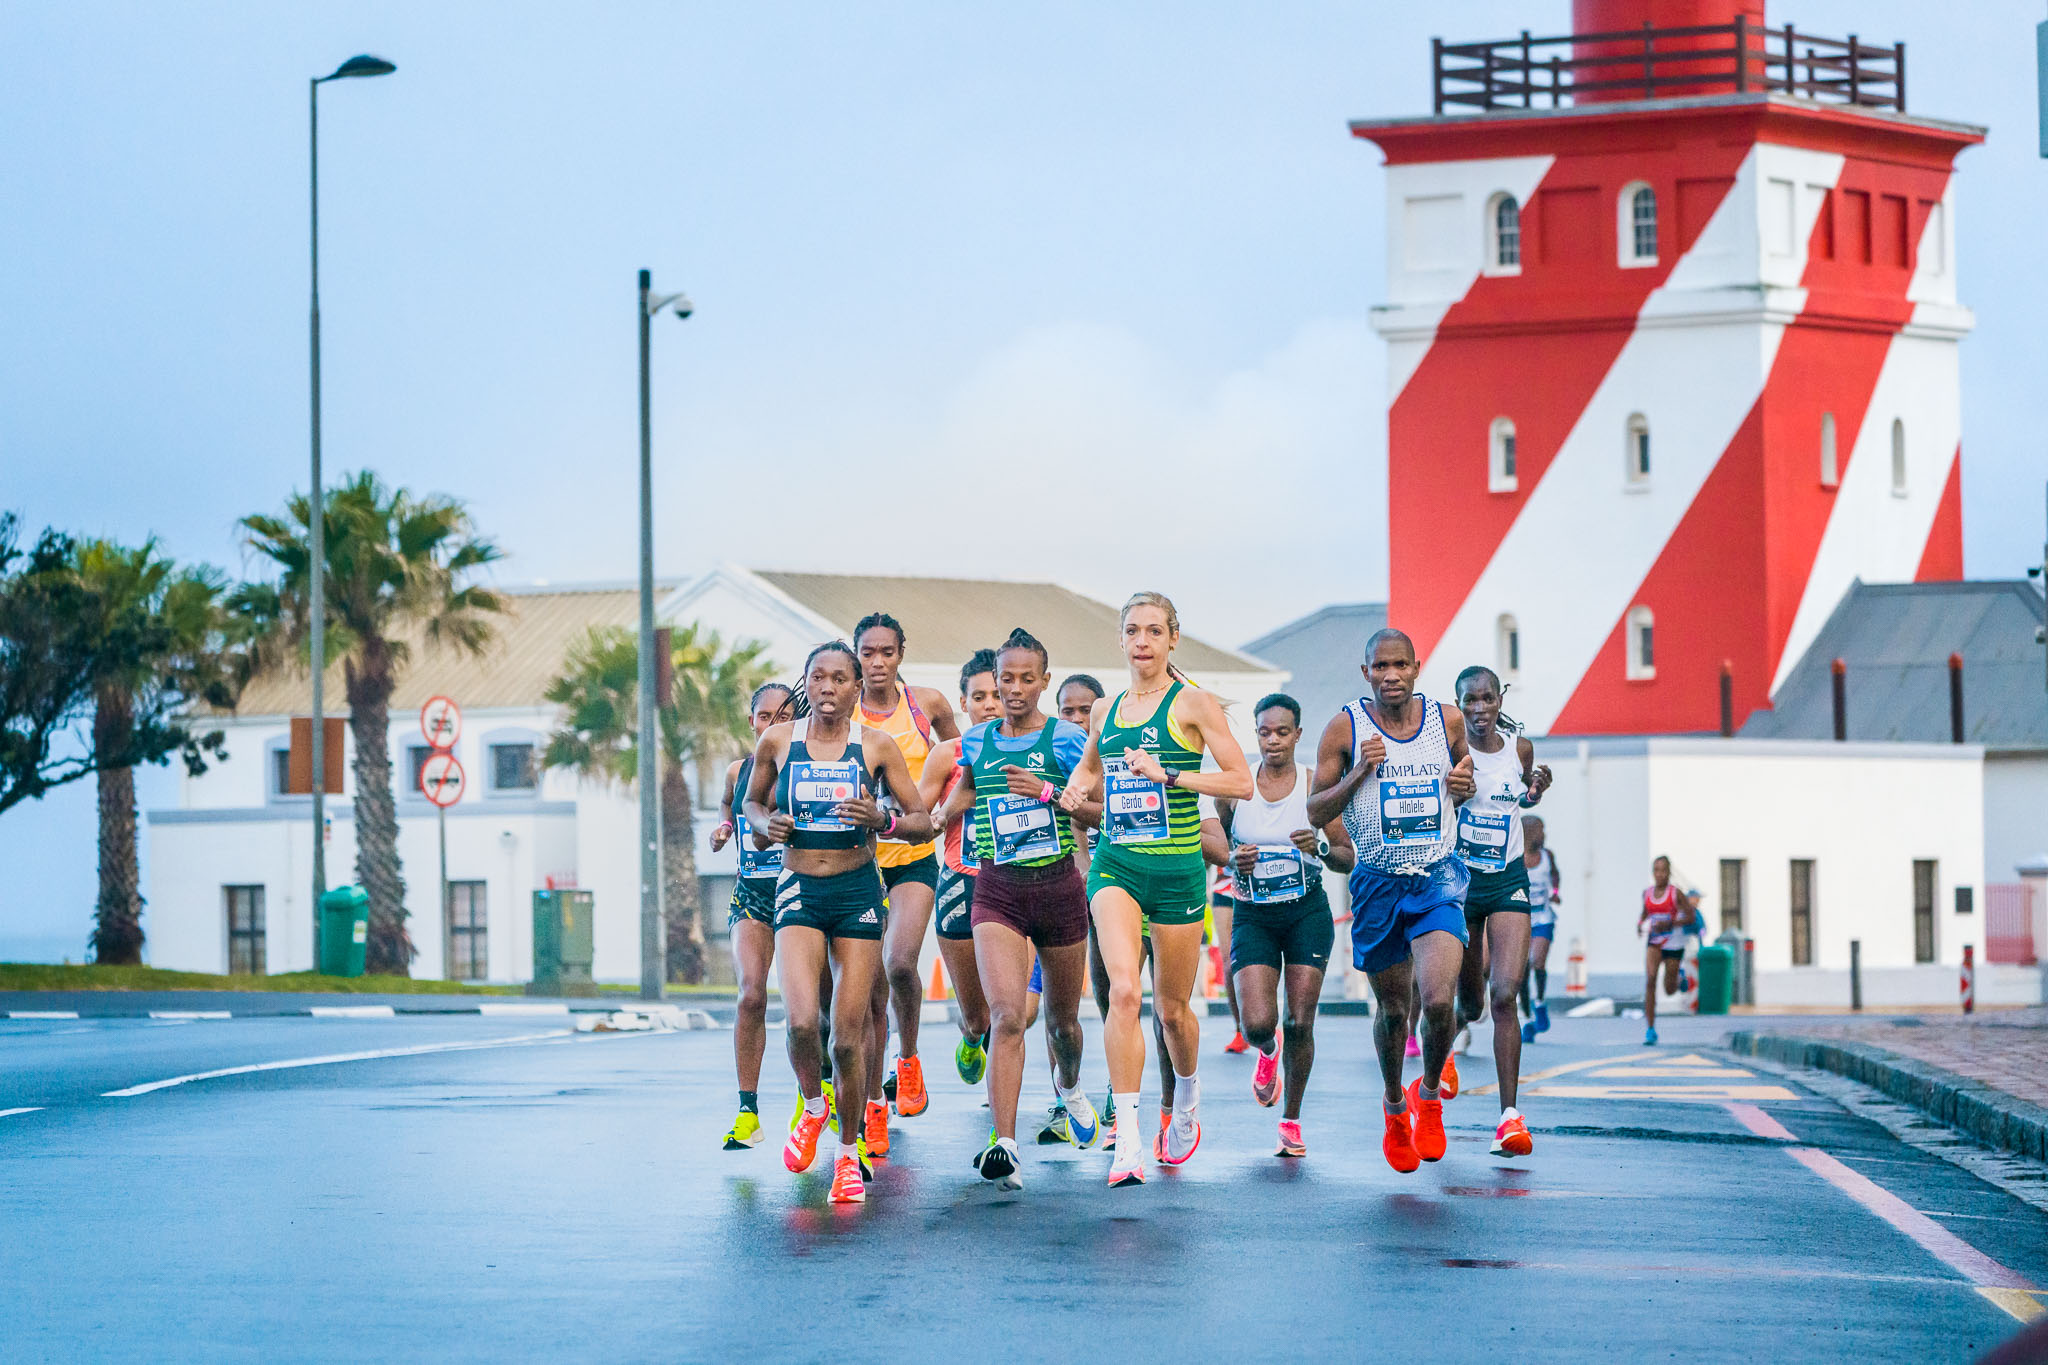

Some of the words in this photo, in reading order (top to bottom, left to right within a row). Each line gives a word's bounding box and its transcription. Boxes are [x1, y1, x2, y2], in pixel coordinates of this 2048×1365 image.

[812, 769, 850, 778] Sanlam
[1386, 763, 1441, 778] IMPLATS
[1119, 779, 1154, 789] Sanlam
[1399, 784, 1434, 794] Sanlam
[816, 784, 834, 800] Lucy
[799, 811, 813, 819] ASA
[1016, 813, 1029, 828] 170
[1474, 816, 1505, 827] Sanlam
[1002, 843, 1016, 852] ASA
[968, 850, 978, 858] AS
